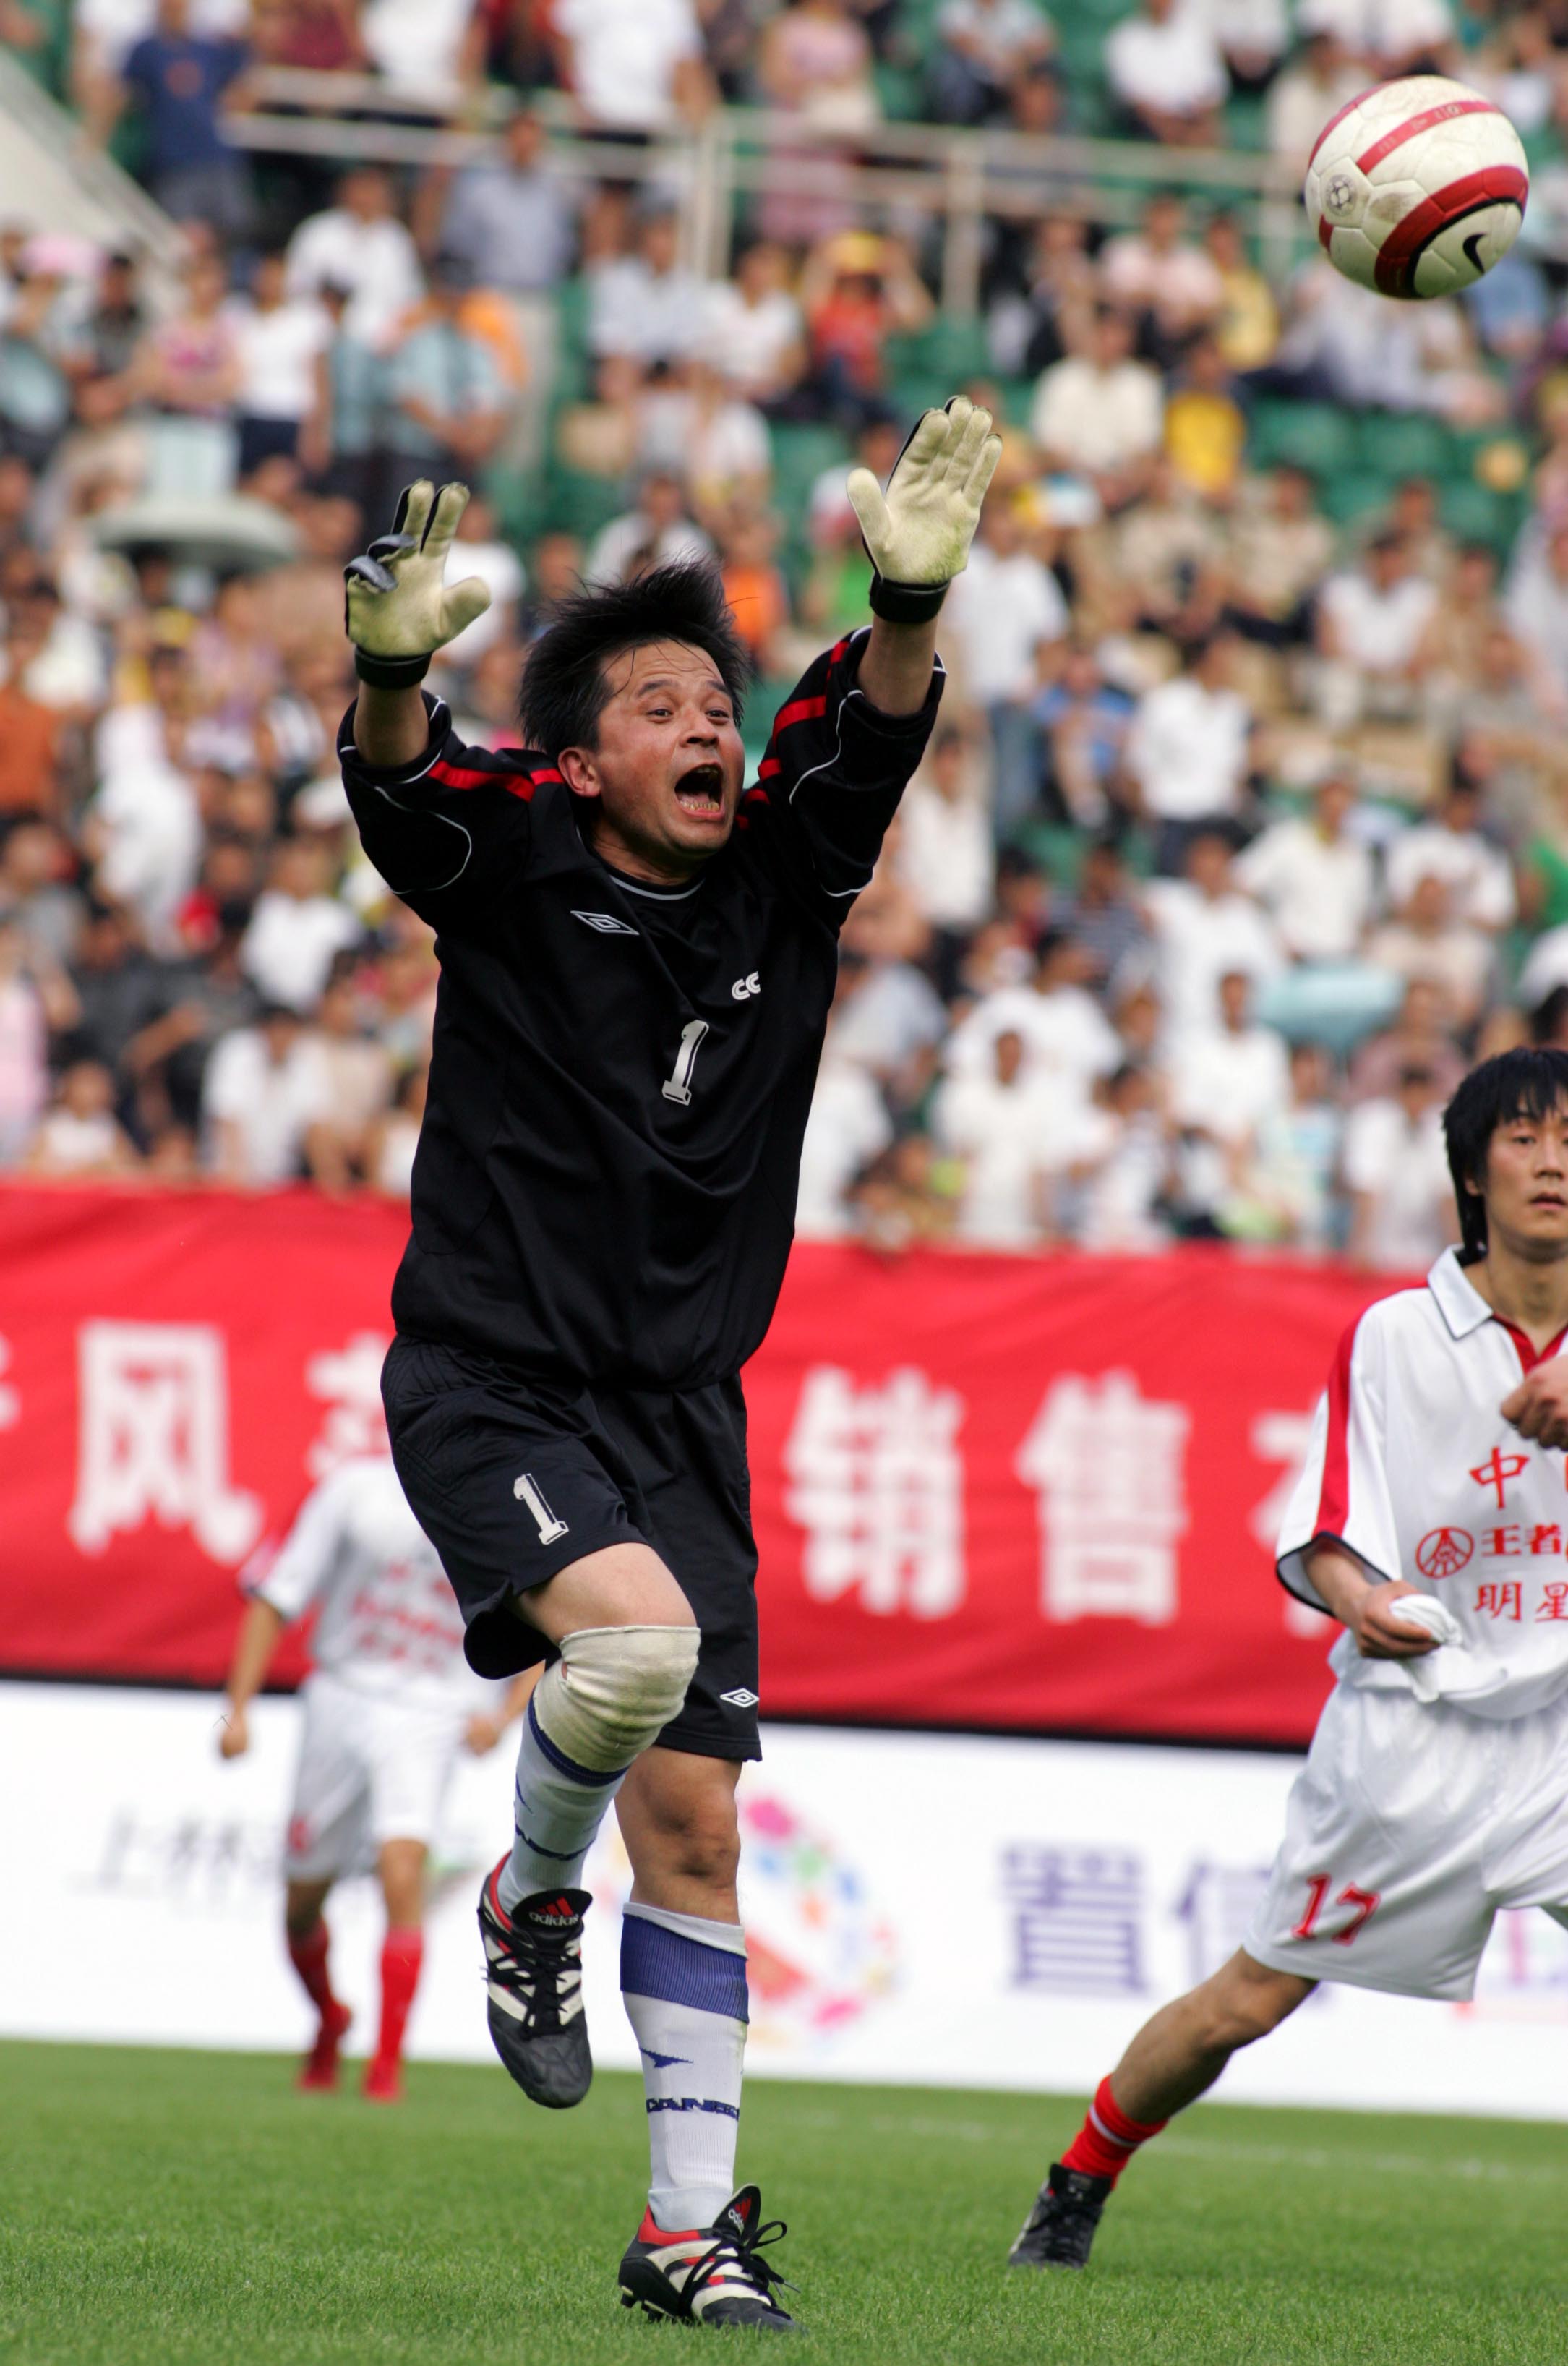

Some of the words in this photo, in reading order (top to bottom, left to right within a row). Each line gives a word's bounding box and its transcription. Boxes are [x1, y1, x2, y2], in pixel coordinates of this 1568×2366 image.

[662, 1019, 709, 1106] 1
[513, 1473, 569, 1545] 1
[1473, 1581, 1568, 1623] 明星
[1291, 1873, 1381, 1947] 17
